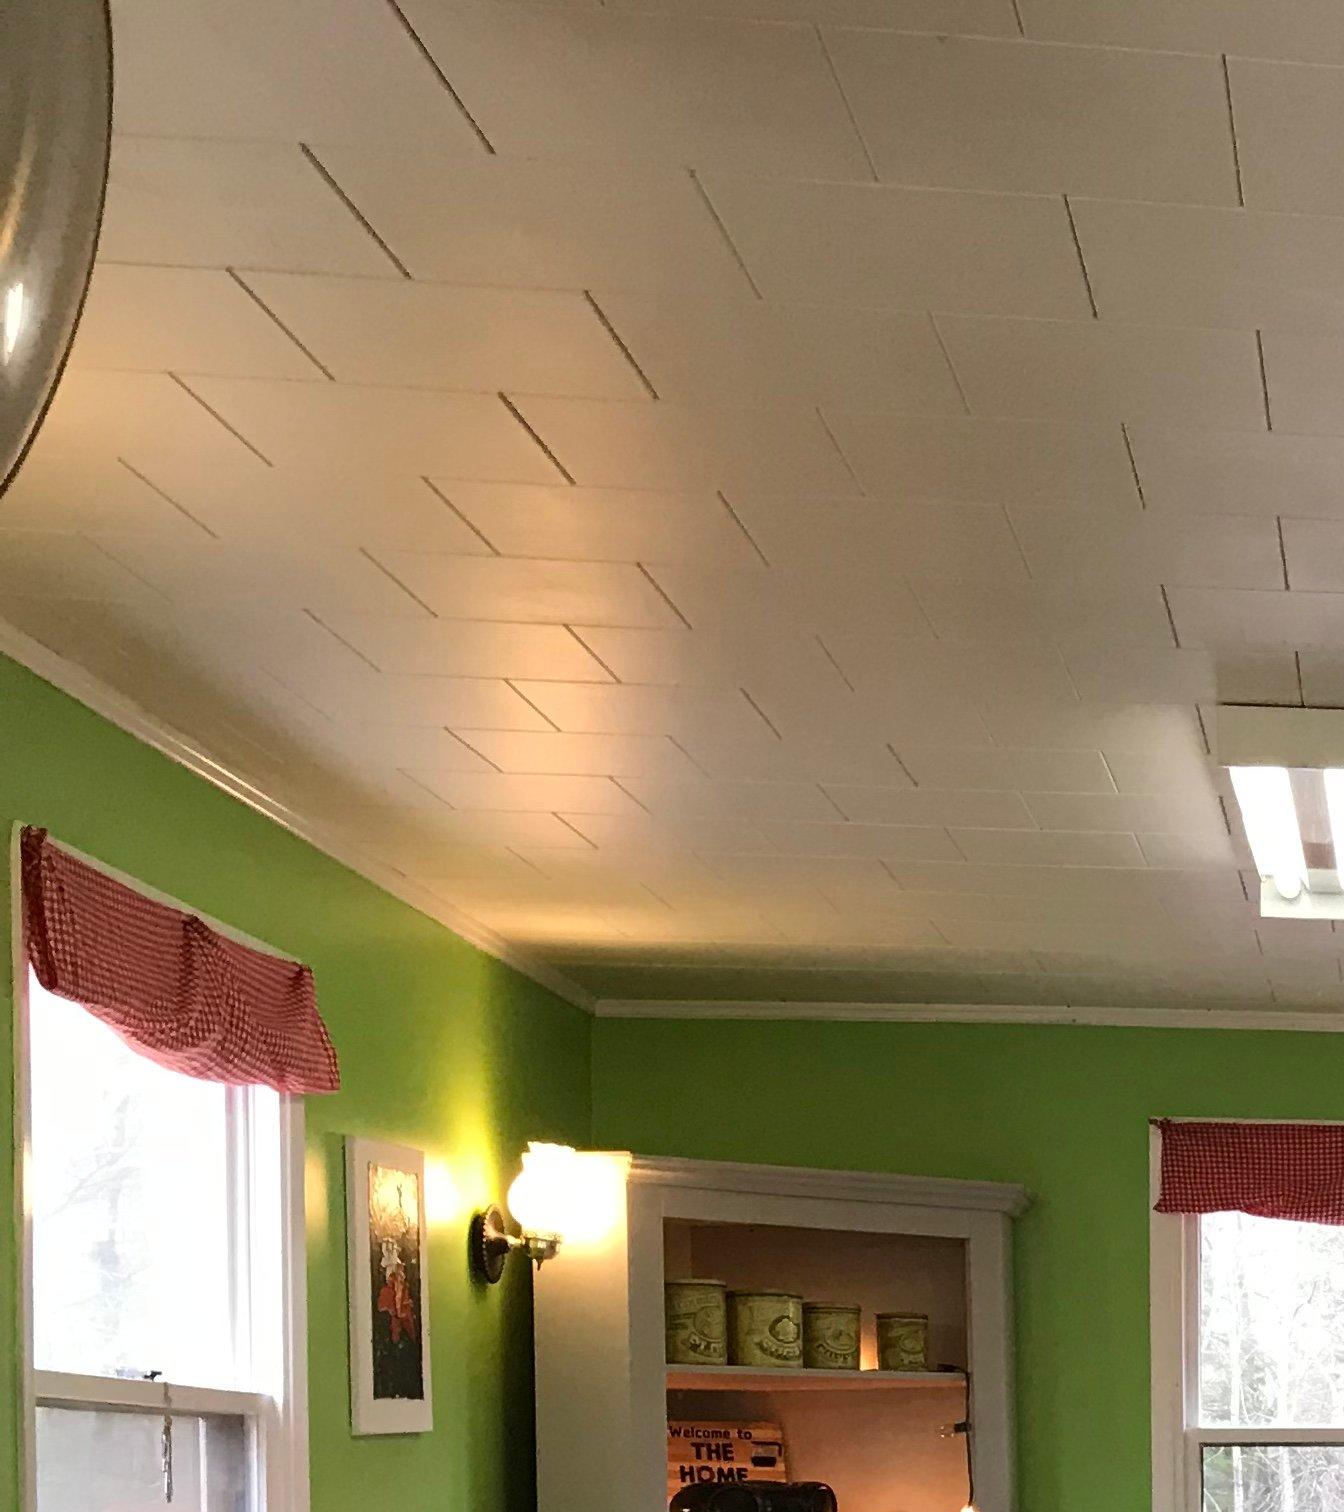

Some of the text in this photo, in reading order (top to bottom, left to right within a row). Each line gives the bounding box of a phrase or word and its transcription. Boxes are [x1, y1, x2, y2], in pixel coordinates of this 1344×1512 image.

[668, 1425, 752, 1440] Welcome to
[690, 1441, 735, 1462] THE
[679, 1465, 749, 1484] HOME
